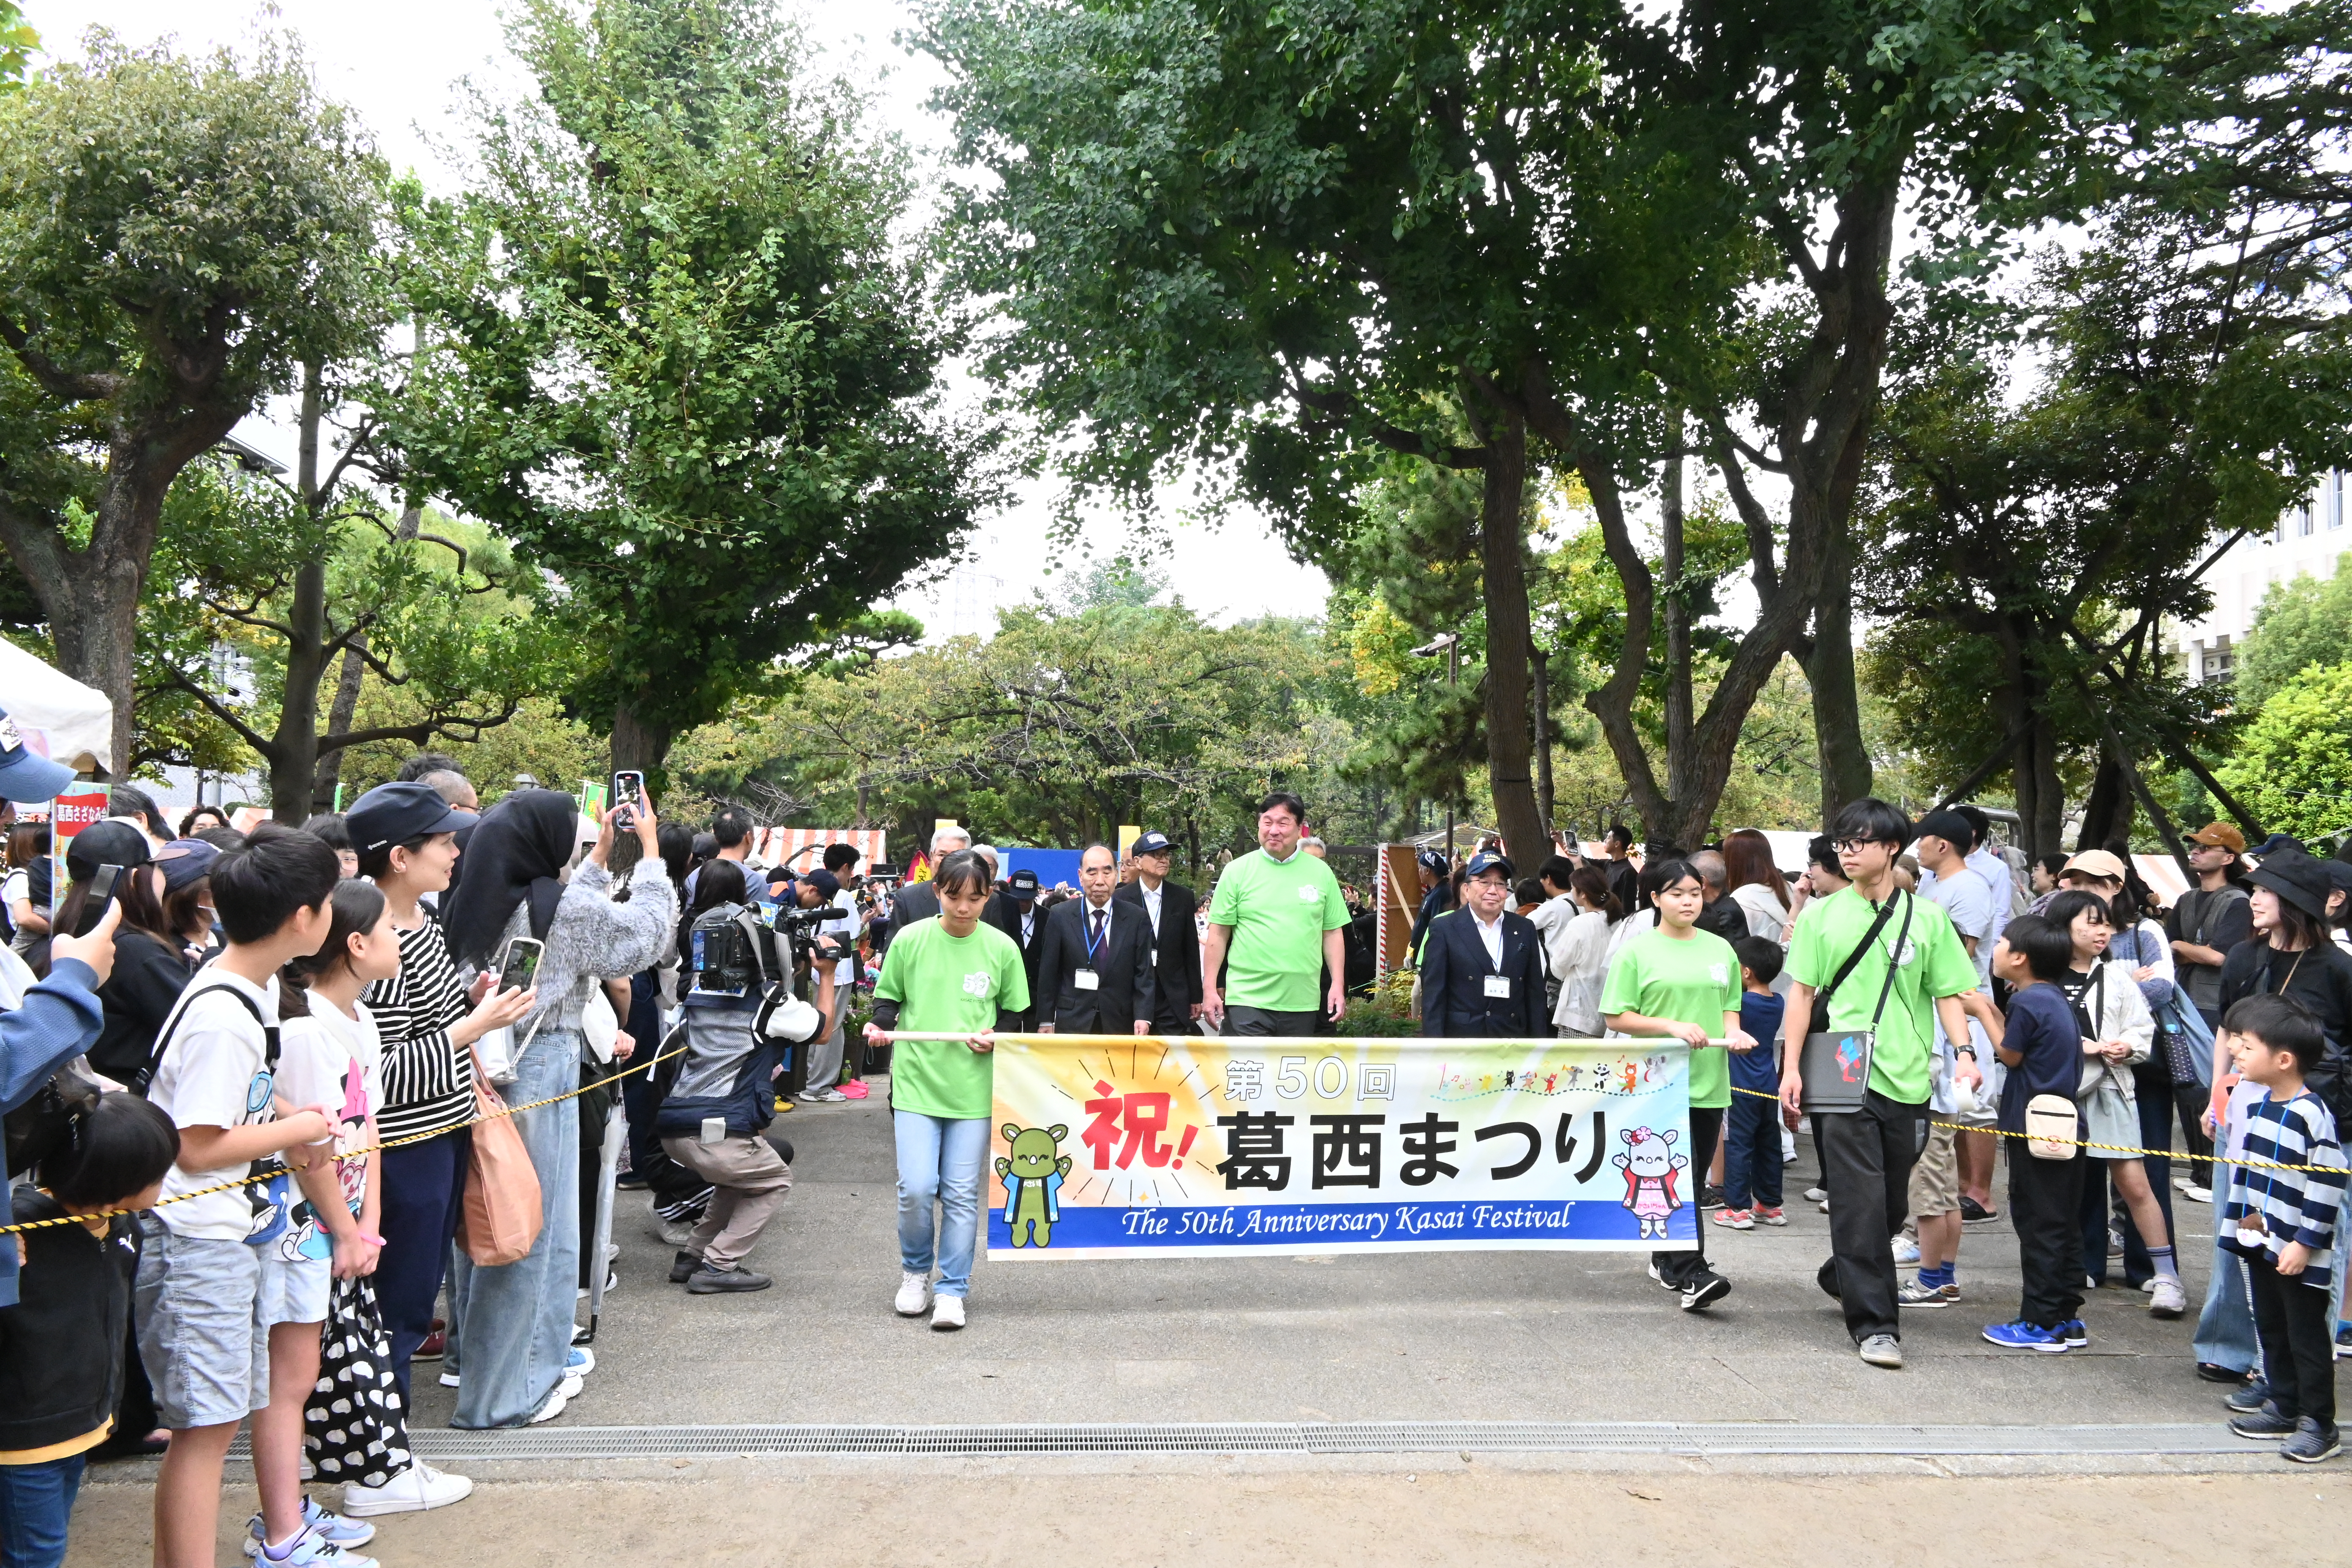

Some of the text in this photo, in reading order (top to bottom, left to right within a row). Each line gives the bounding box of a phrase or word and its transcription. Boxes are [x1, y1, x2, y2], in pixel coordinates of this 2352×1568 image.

[1224, 1056, 1396, 1101] 第50回
[1216, 1111, 1606, 1191] 葛西まつり
[1122, 1201, 1576, 1239] The 50th Anniversary Kasai Festival
